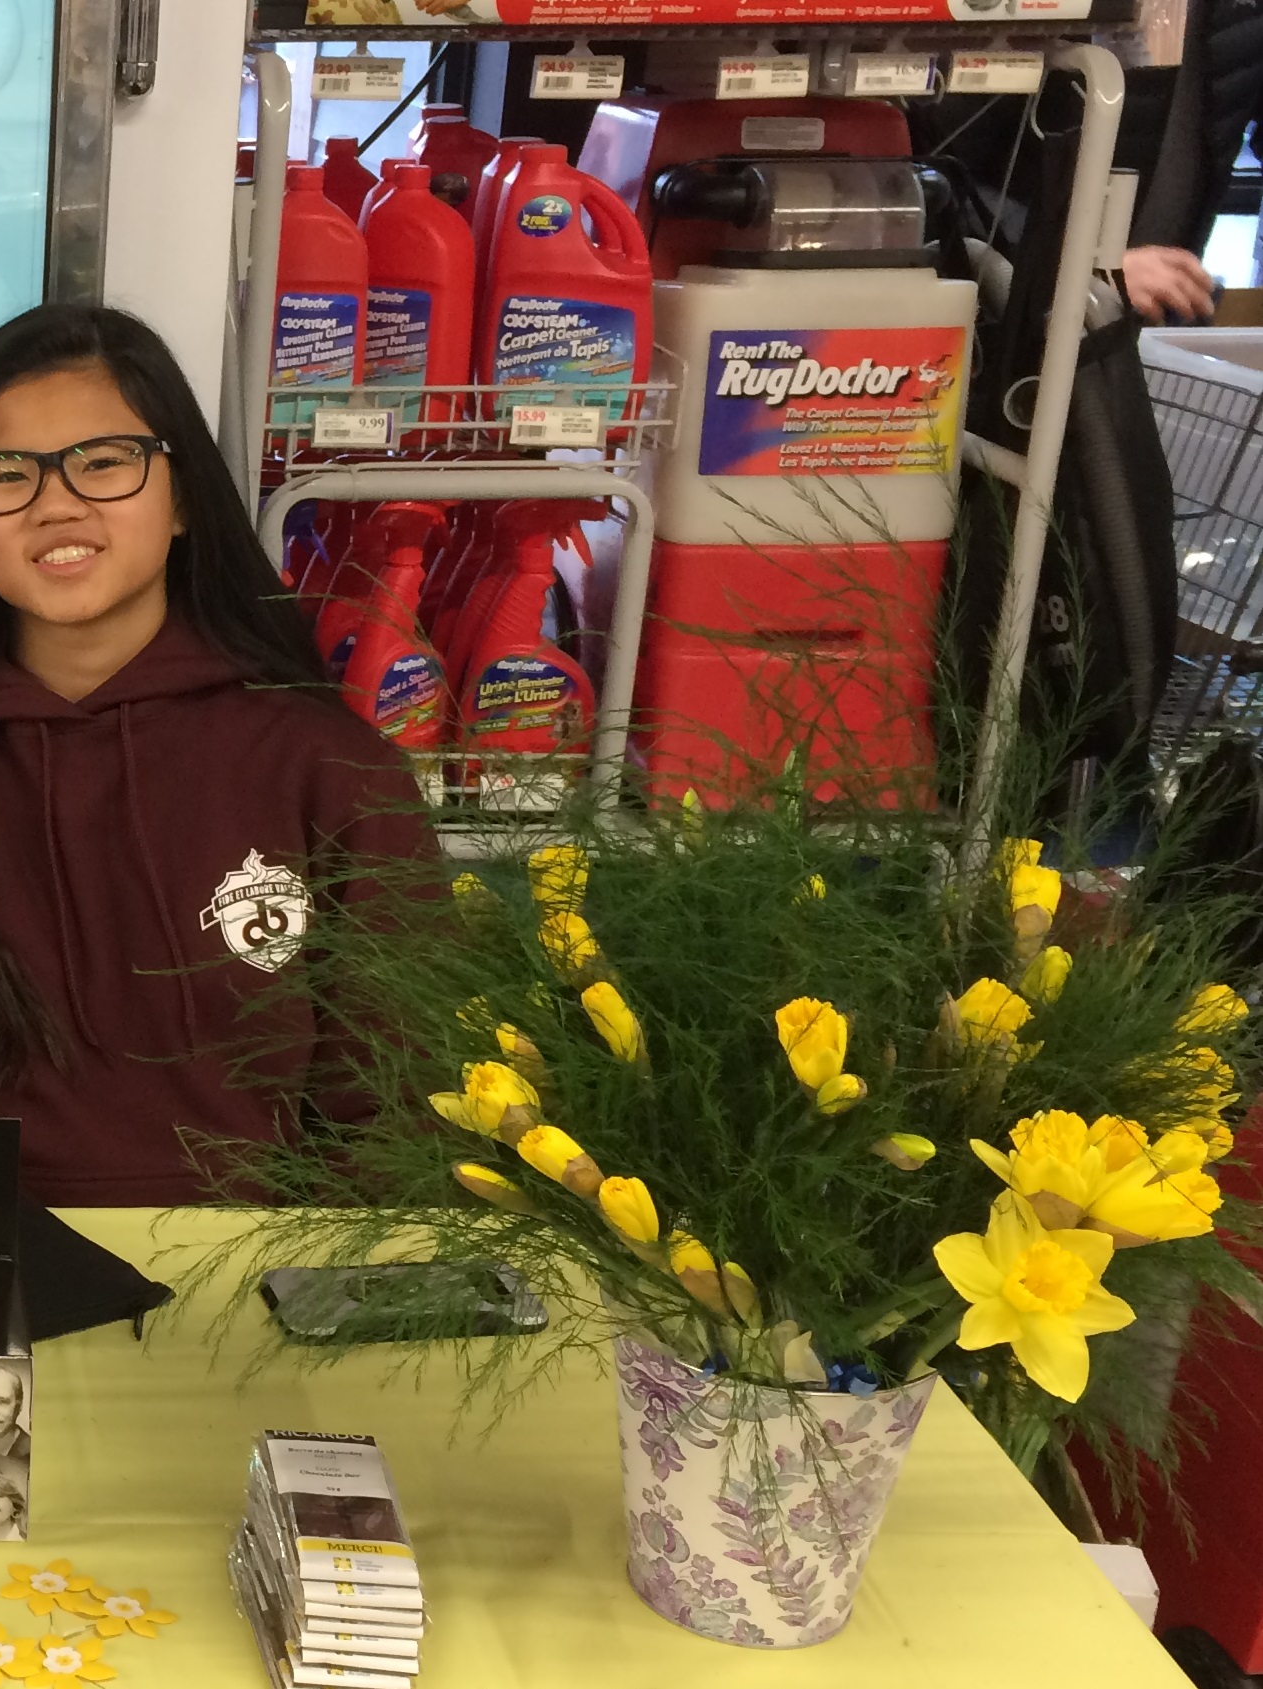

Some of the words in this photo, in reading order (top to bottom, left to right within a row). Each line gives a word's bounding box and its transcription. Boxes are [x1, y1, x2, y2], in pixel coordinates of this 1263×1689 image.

[500, 330, 555, 351] Carpet
[553, 346, 568, 357] de
[569, 338, 611, 360] Tapis
[719, 341, 766, 359] Rent
[769, 341, 803, 359] The
[716, 358, 910, 406] RugDoctor
[358, 417, 385, 429] 9.99
[514, 688, 561, 703] L'Urine
[235, 889, 244, 900] ET
[326, 1542, 383, 1554] MERCI!
